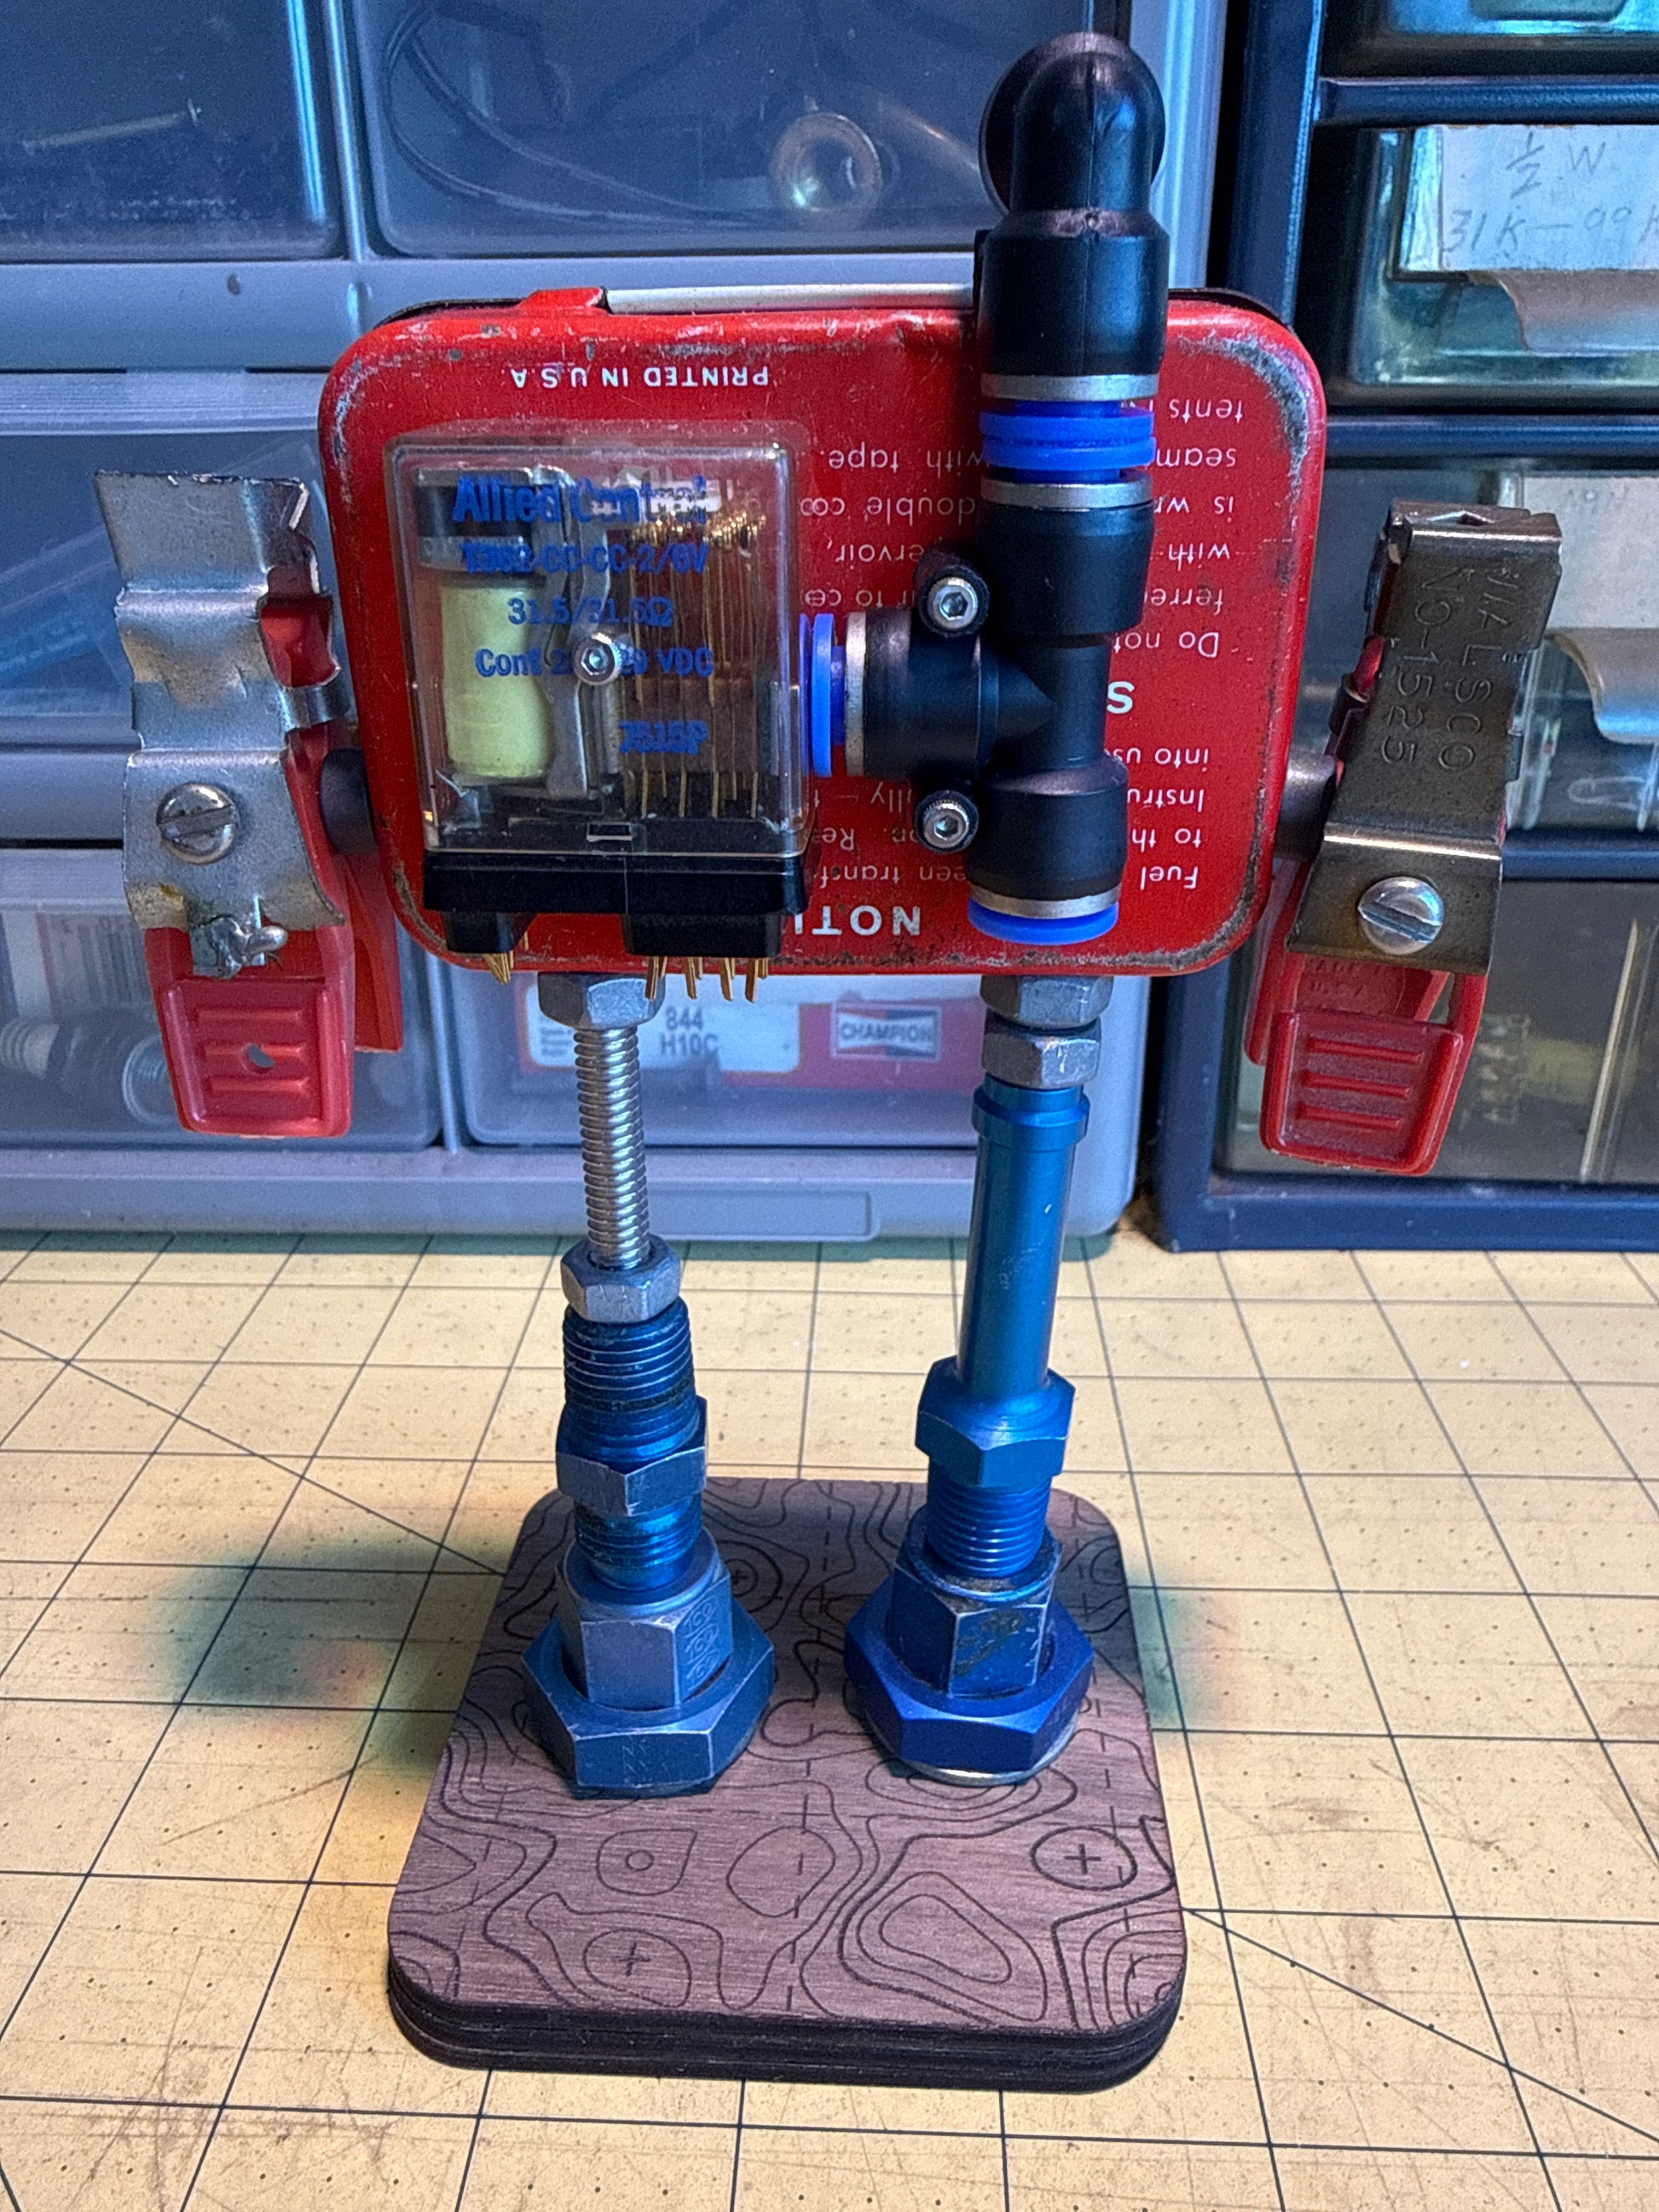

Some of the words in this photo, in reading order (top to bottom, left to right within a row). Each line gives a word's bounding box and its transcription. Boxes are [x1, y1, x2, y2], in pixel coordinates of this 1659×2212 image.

[1568, 141, 1606, 176] W
[601, 367, 628, 388] IN
[644, 367, 768, 388] PRINTED
[1169, 399, 1242, 424] tents
[1156, 448, 1237, 468] seam
[452, 474, 561, 523] Allied
[1153, 497, 1190, 514] wr
[1213, 496, 1234, 523] is
[864, 497, 975, 526] double
[1168, 543, 1230, 571] with
[1113, 632, 1160, 654] not
[1178, 632, 1219, 658] Do
[656, 646, 714, 678] VDC
[1106, 681, 1135, 713] S
[1154, 748, 1209, 771] into
[1127, 788, 1204, 812] Instru
[1132, 829, 1156, 852] th
[1174, 828, 1201, 848] to
[920, 866, 966, 881] een
[1140, 866, 1198, 890] Fuel
[795, 904, 922, 936] NOTI
[666, 1006, 704, 1031] 844
[659, 1032, 720, 1056] H10C
[839, 1021, 935, 1044] CHAMPION
